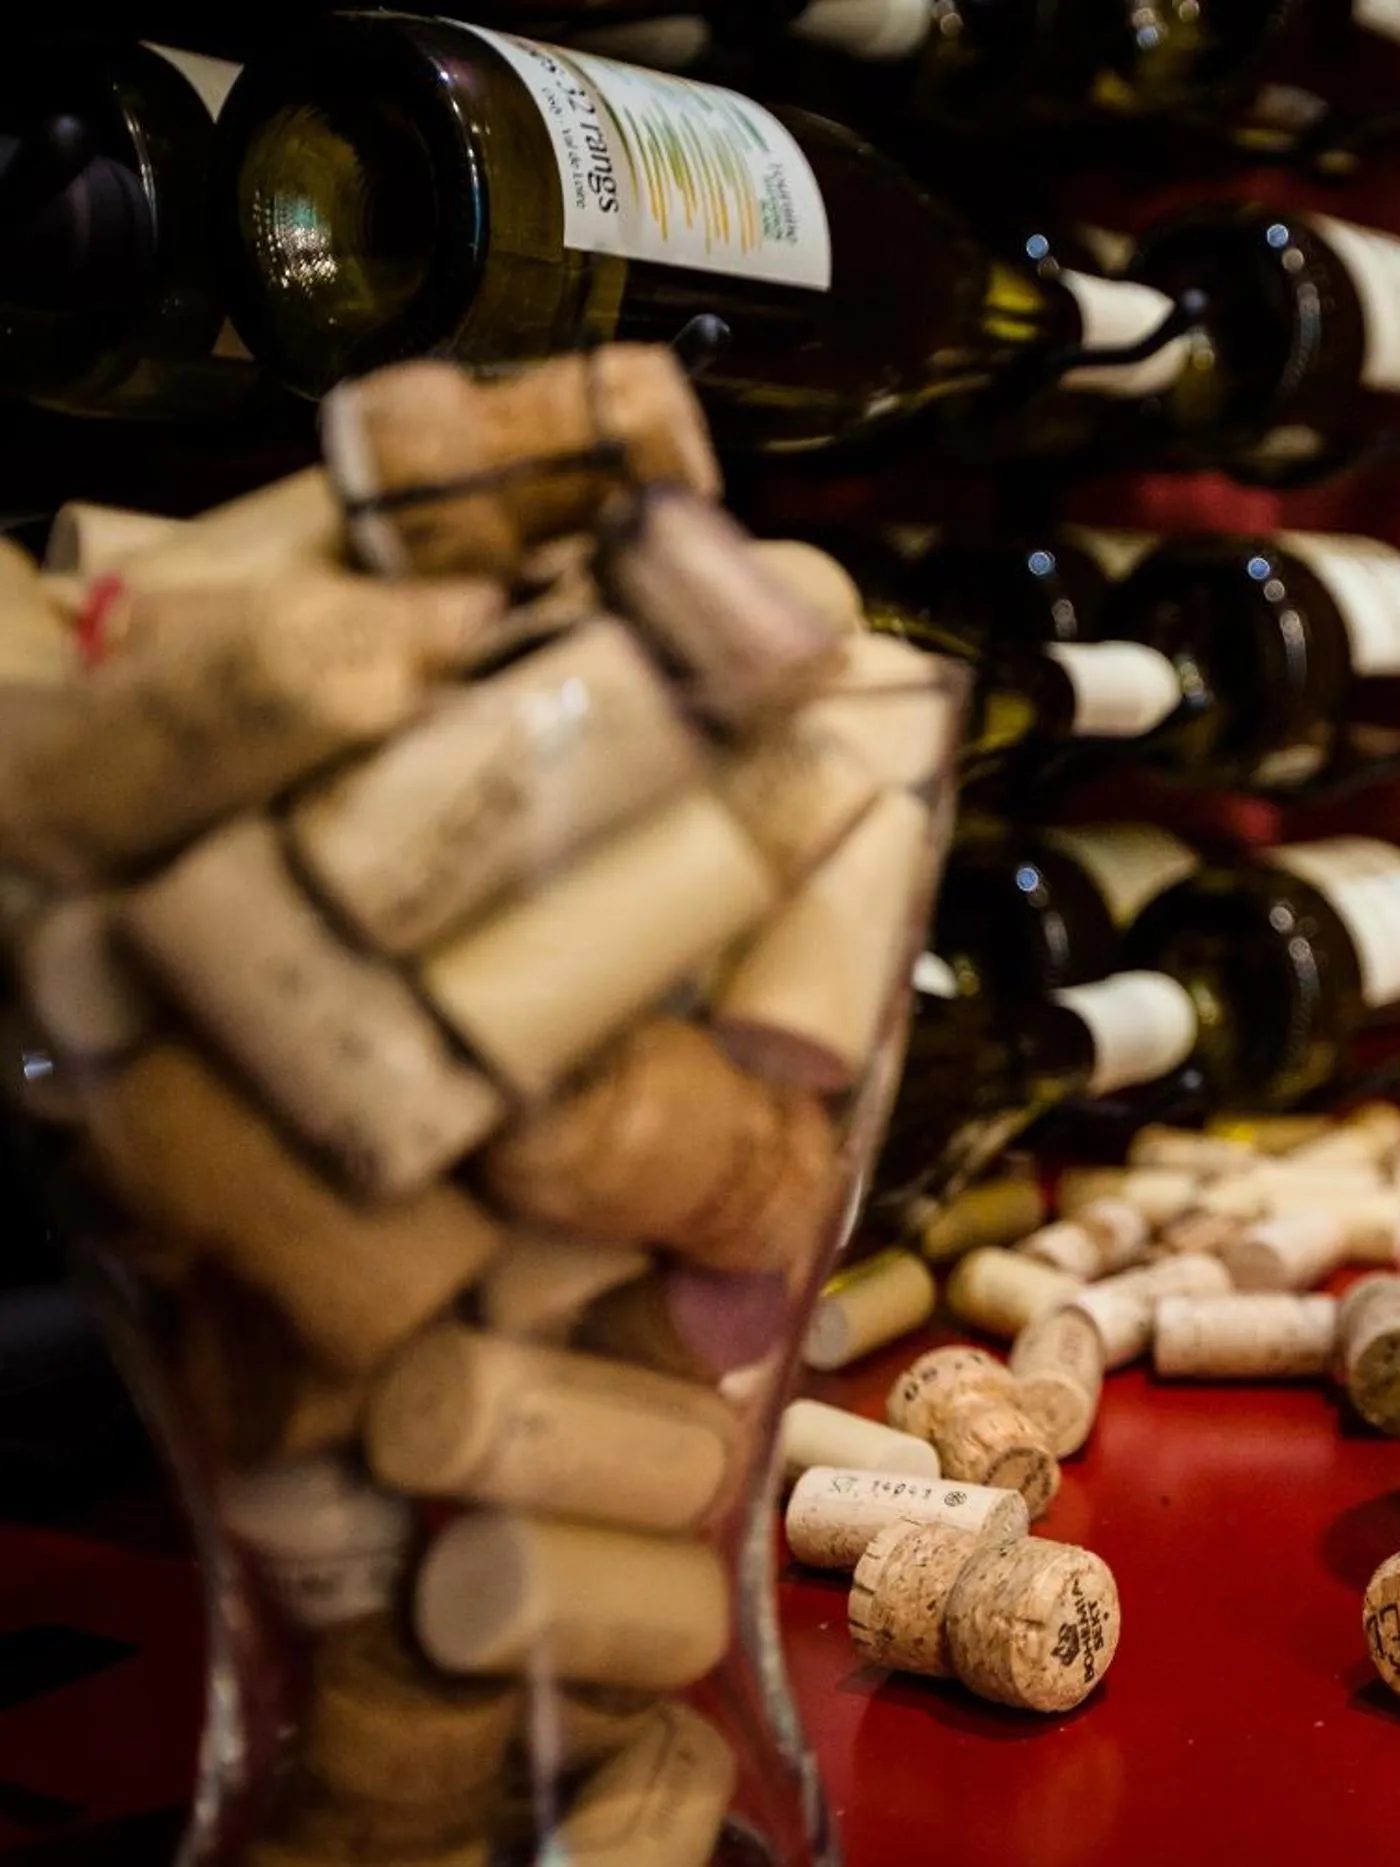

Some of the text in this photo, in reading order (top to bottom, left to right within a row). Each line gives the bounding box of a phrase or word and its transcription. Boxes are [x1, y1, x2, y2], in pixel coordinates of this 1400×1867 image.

[579, 122, 620, 214] rangs
[1071, 1578, 1095, 1684] BOHEMIA
[1087, 1600, 1104, 1653] SEKT
